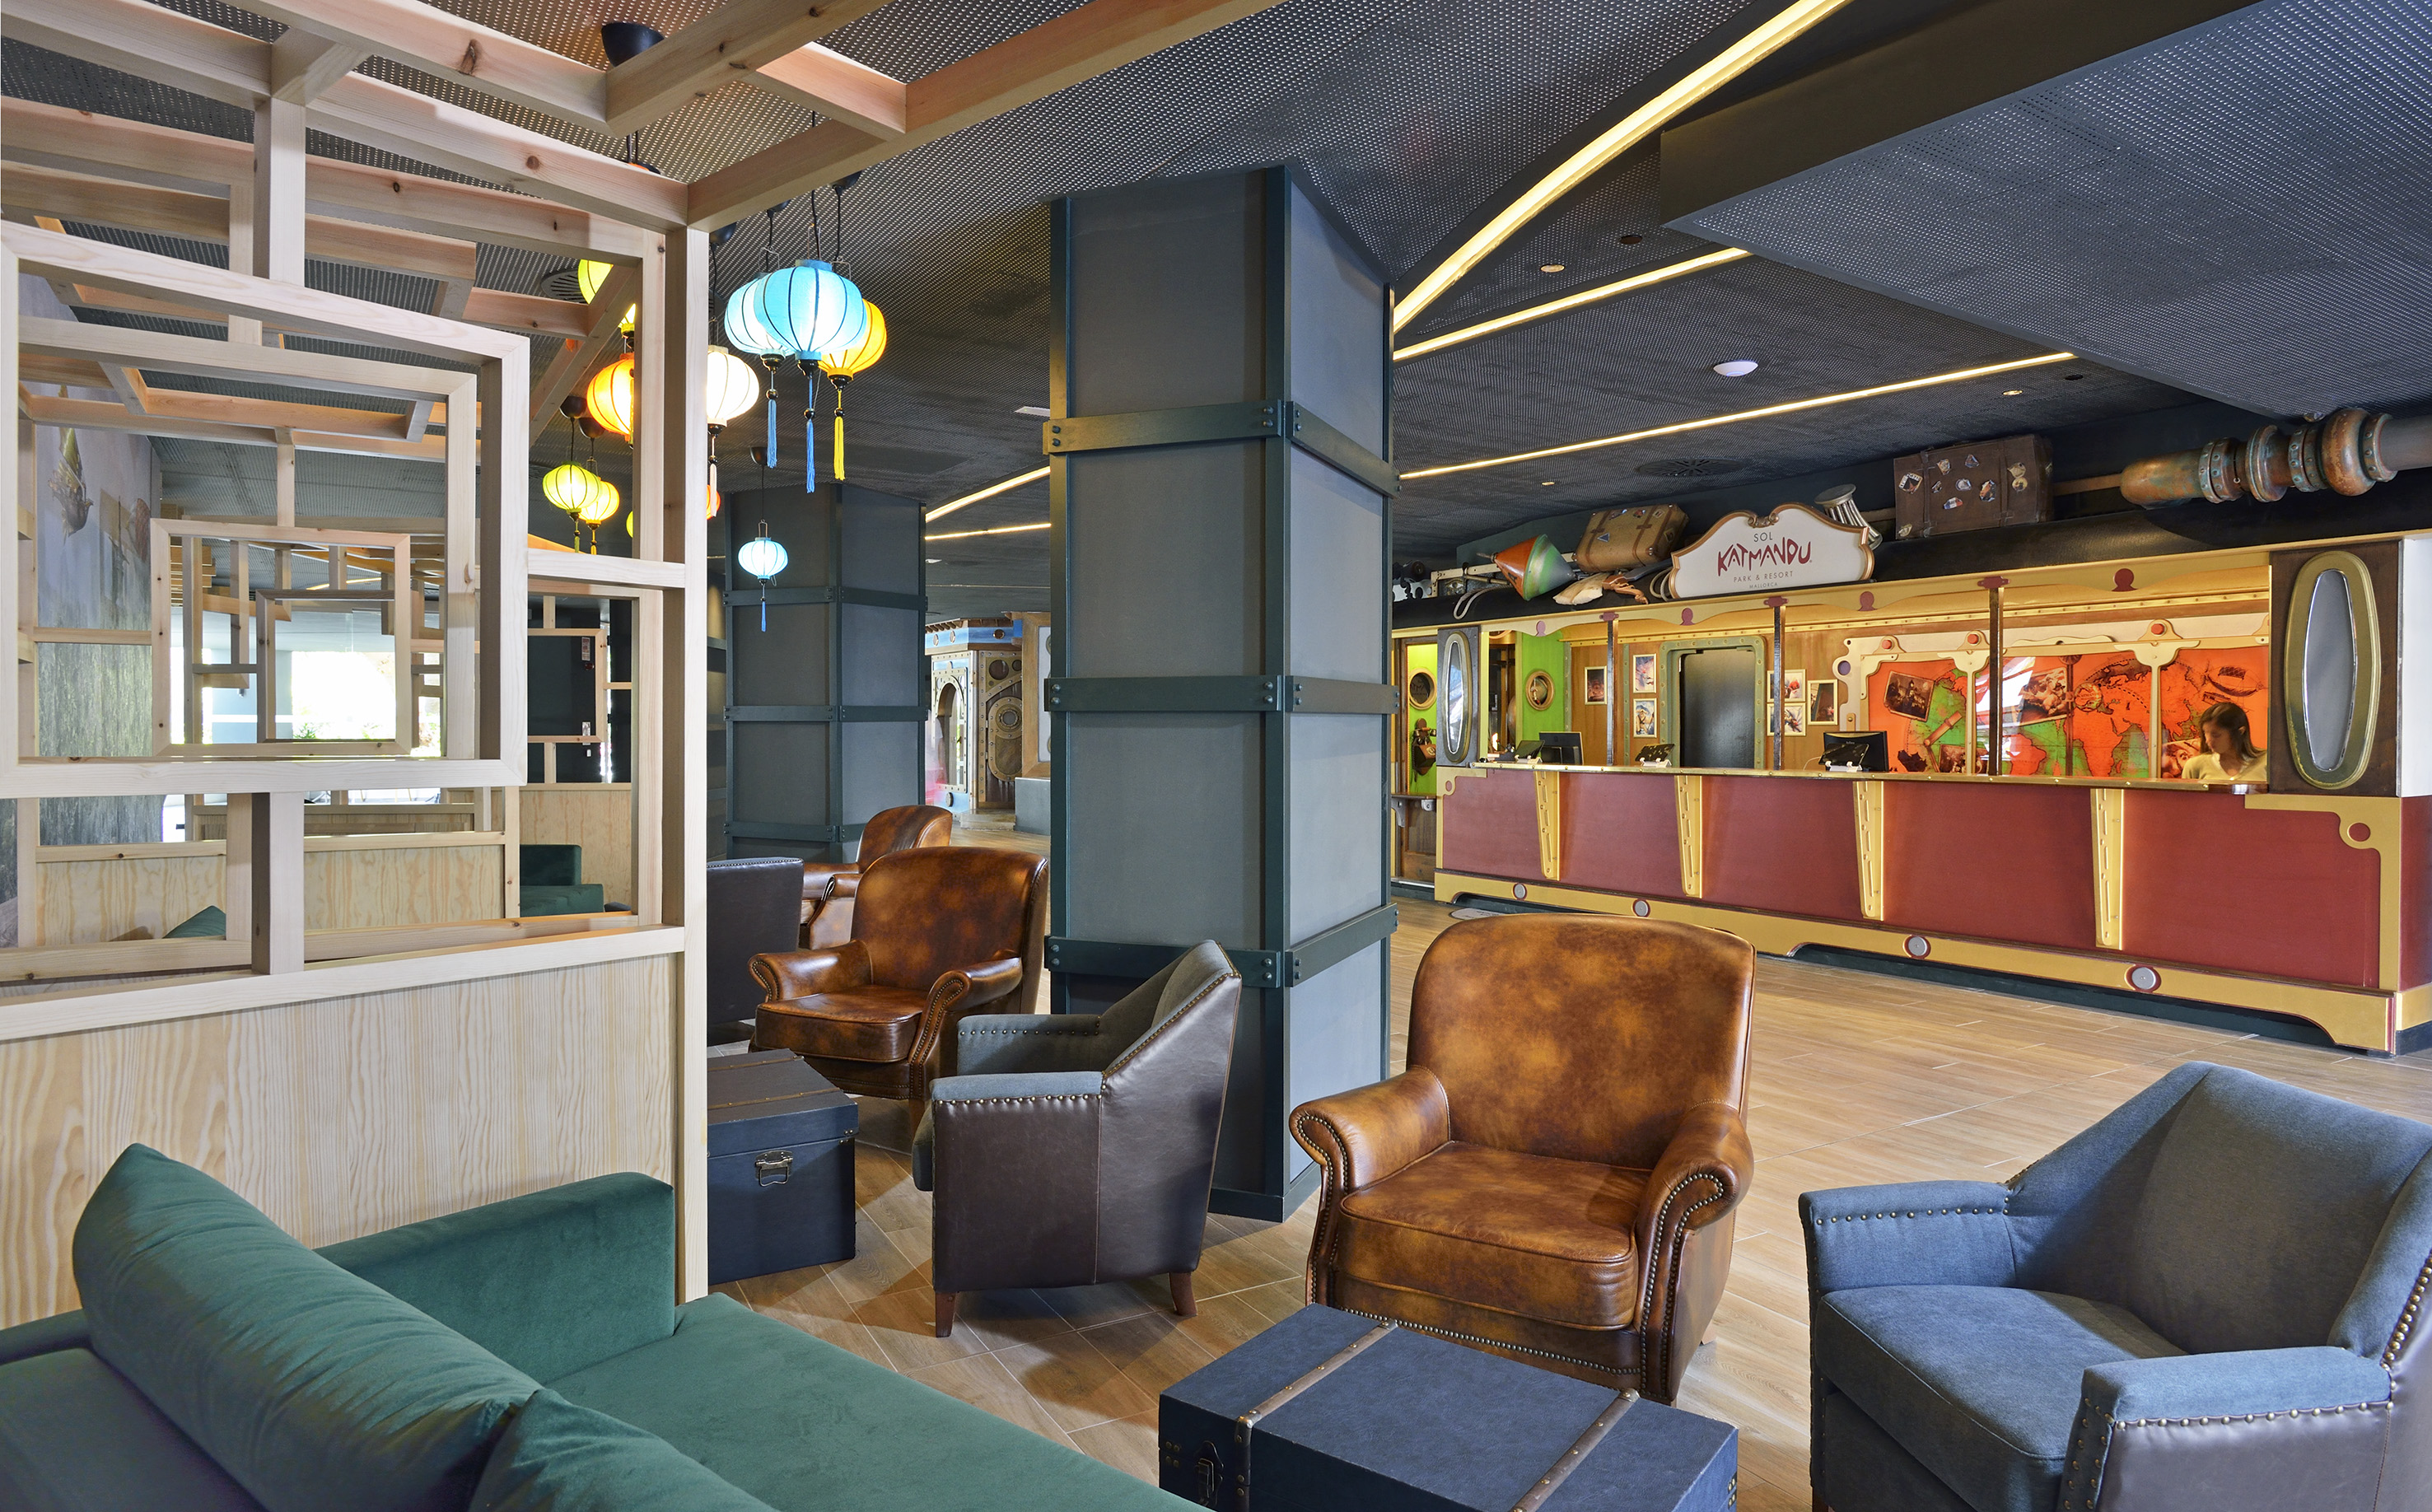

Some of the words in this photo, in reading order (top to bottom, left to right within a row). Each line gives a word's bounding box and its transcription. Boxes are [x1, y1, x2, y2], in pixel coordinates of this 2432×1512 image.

[1753, 532, 1773, 543] SOL
[1717, 537, 1811, 576] KATMANDU
[1733, 575, 1752, 583] PARK
[1764, 571, 1794, 580] RESORT
